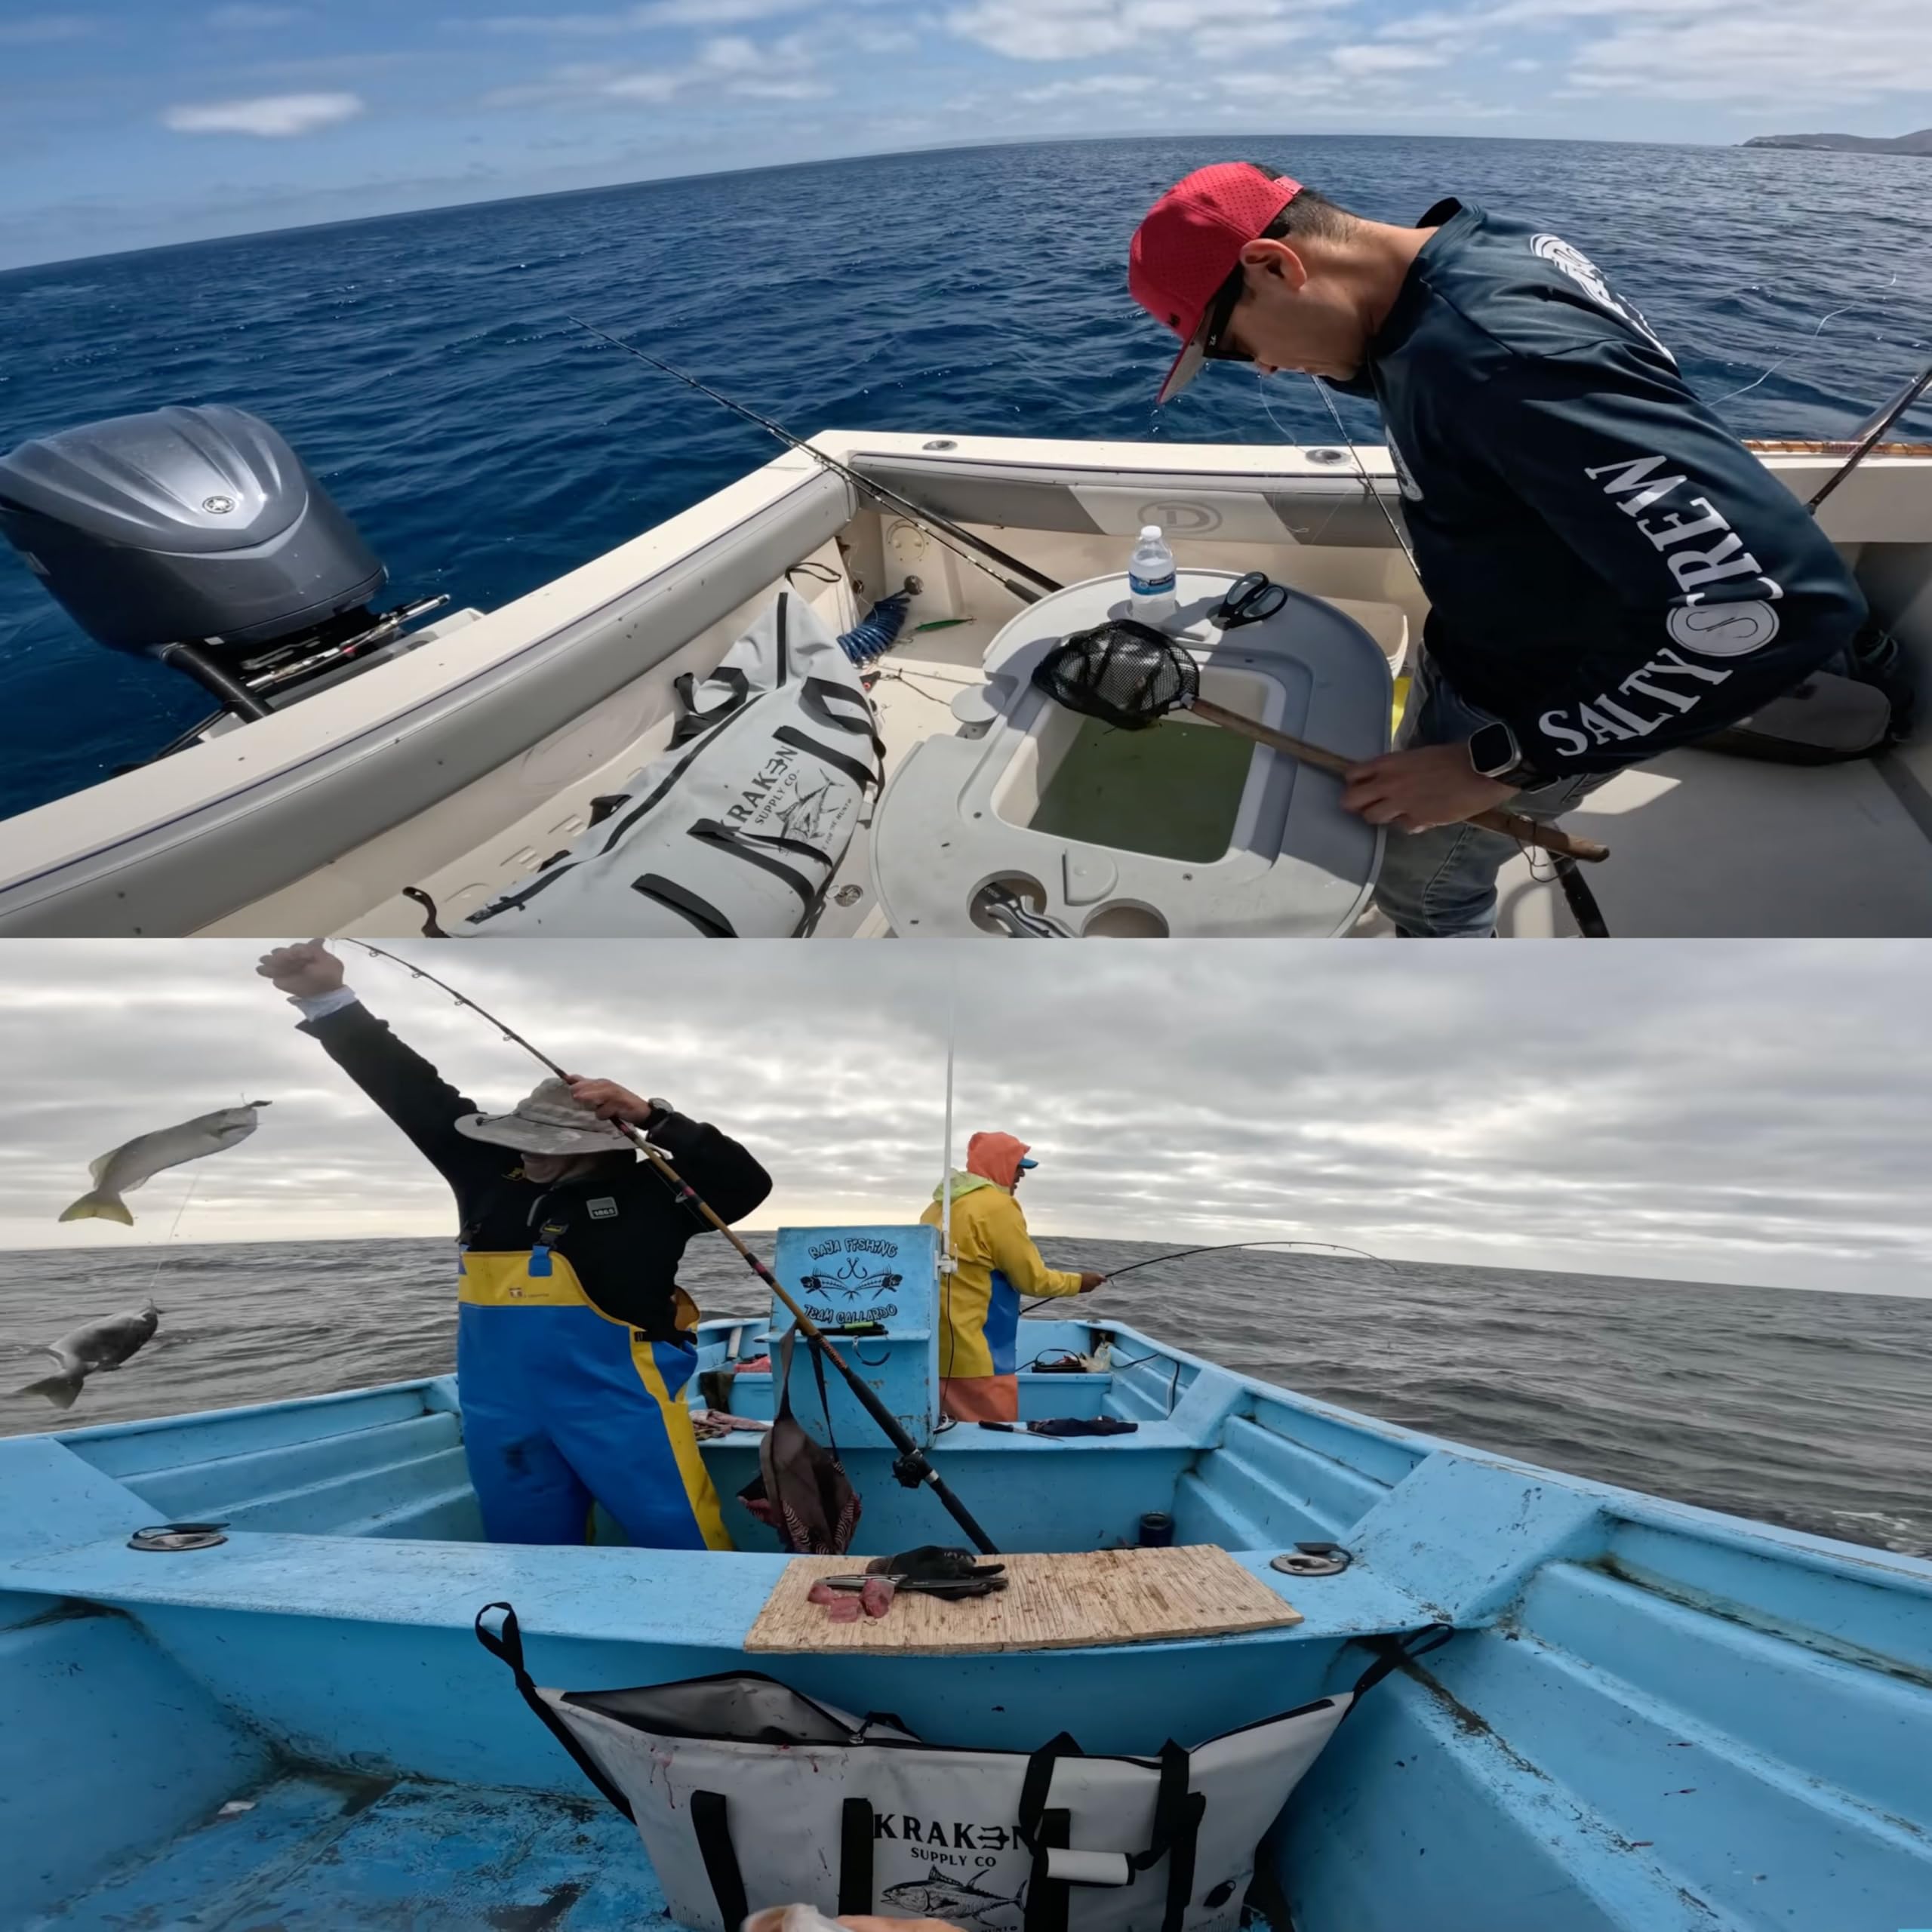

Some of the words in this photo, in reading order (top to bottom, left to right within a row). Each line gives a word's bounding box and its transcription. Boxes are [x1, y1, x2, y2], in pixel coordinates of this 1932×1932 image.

[1538, 648, 1734, 756] SALTY
[755, 786, 786, 825] SUPPLY
[808, 1239, 841, 1260] BAJA
[804, 1304, 834, 1324] TEAM
[835, 1303, 897, 1324] GALLARDO
[910, 1847, 968, 1866] SUPPLY
[974, 1856, 997, 1867] CO
